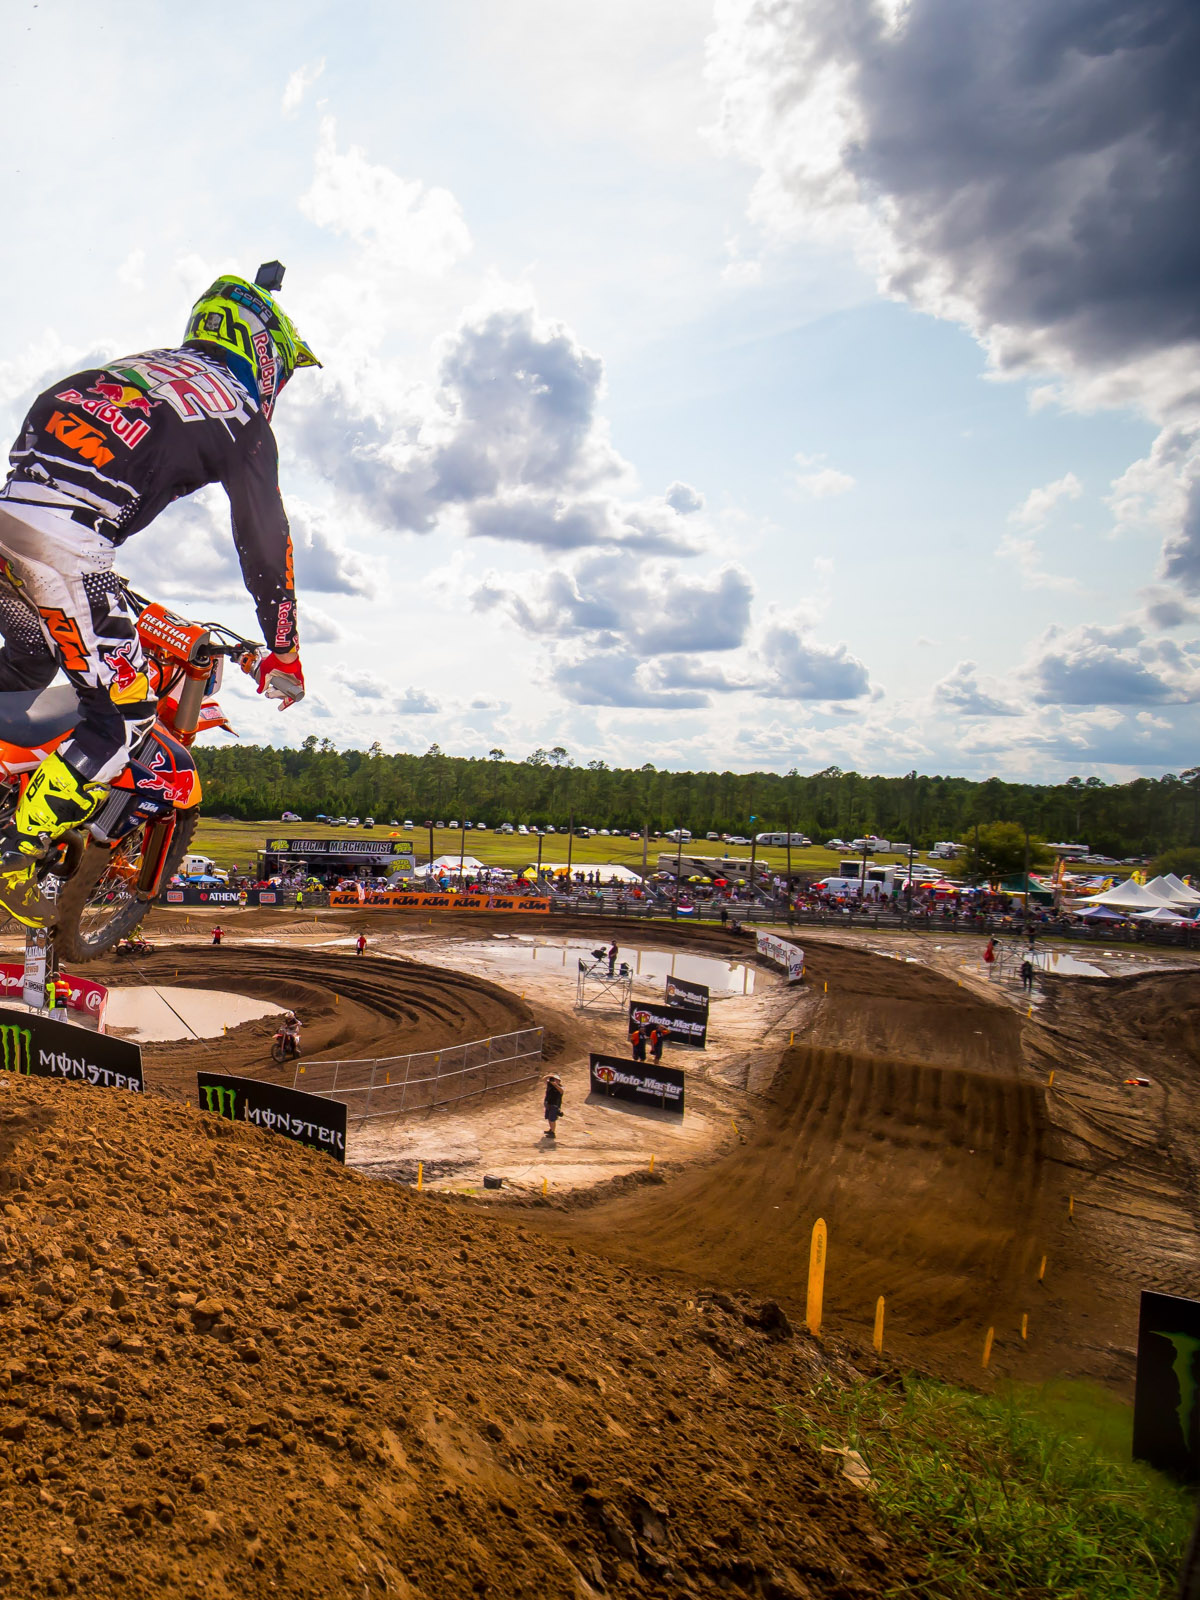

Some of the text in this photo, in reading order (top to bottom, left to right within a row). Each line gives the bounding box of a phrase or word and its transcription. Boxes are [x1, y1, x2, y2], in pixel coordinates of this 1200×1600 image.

[44, 410, 115, 469] KTM
[39, 606, 89, 672] KTM
[140, 621, 188, 653] RENTHAL
[142, 613, 192, 645] RENTHAL
[138, 801, 159, 813] KTM
[292, 841, 392, 854] OFFICIAL MERCHANDISE
[332, 894, 360, 905] KTM
[392, 895, 419, 906] KTM
[422, 896, 450, 907] KTM
[452, 897, 480, 908] KTM
[518, 899, 547, 911] KTM
[649, 1015, 705, 1032] Moto-Master
[614, 1072, 683, 1094] Moto-Master
